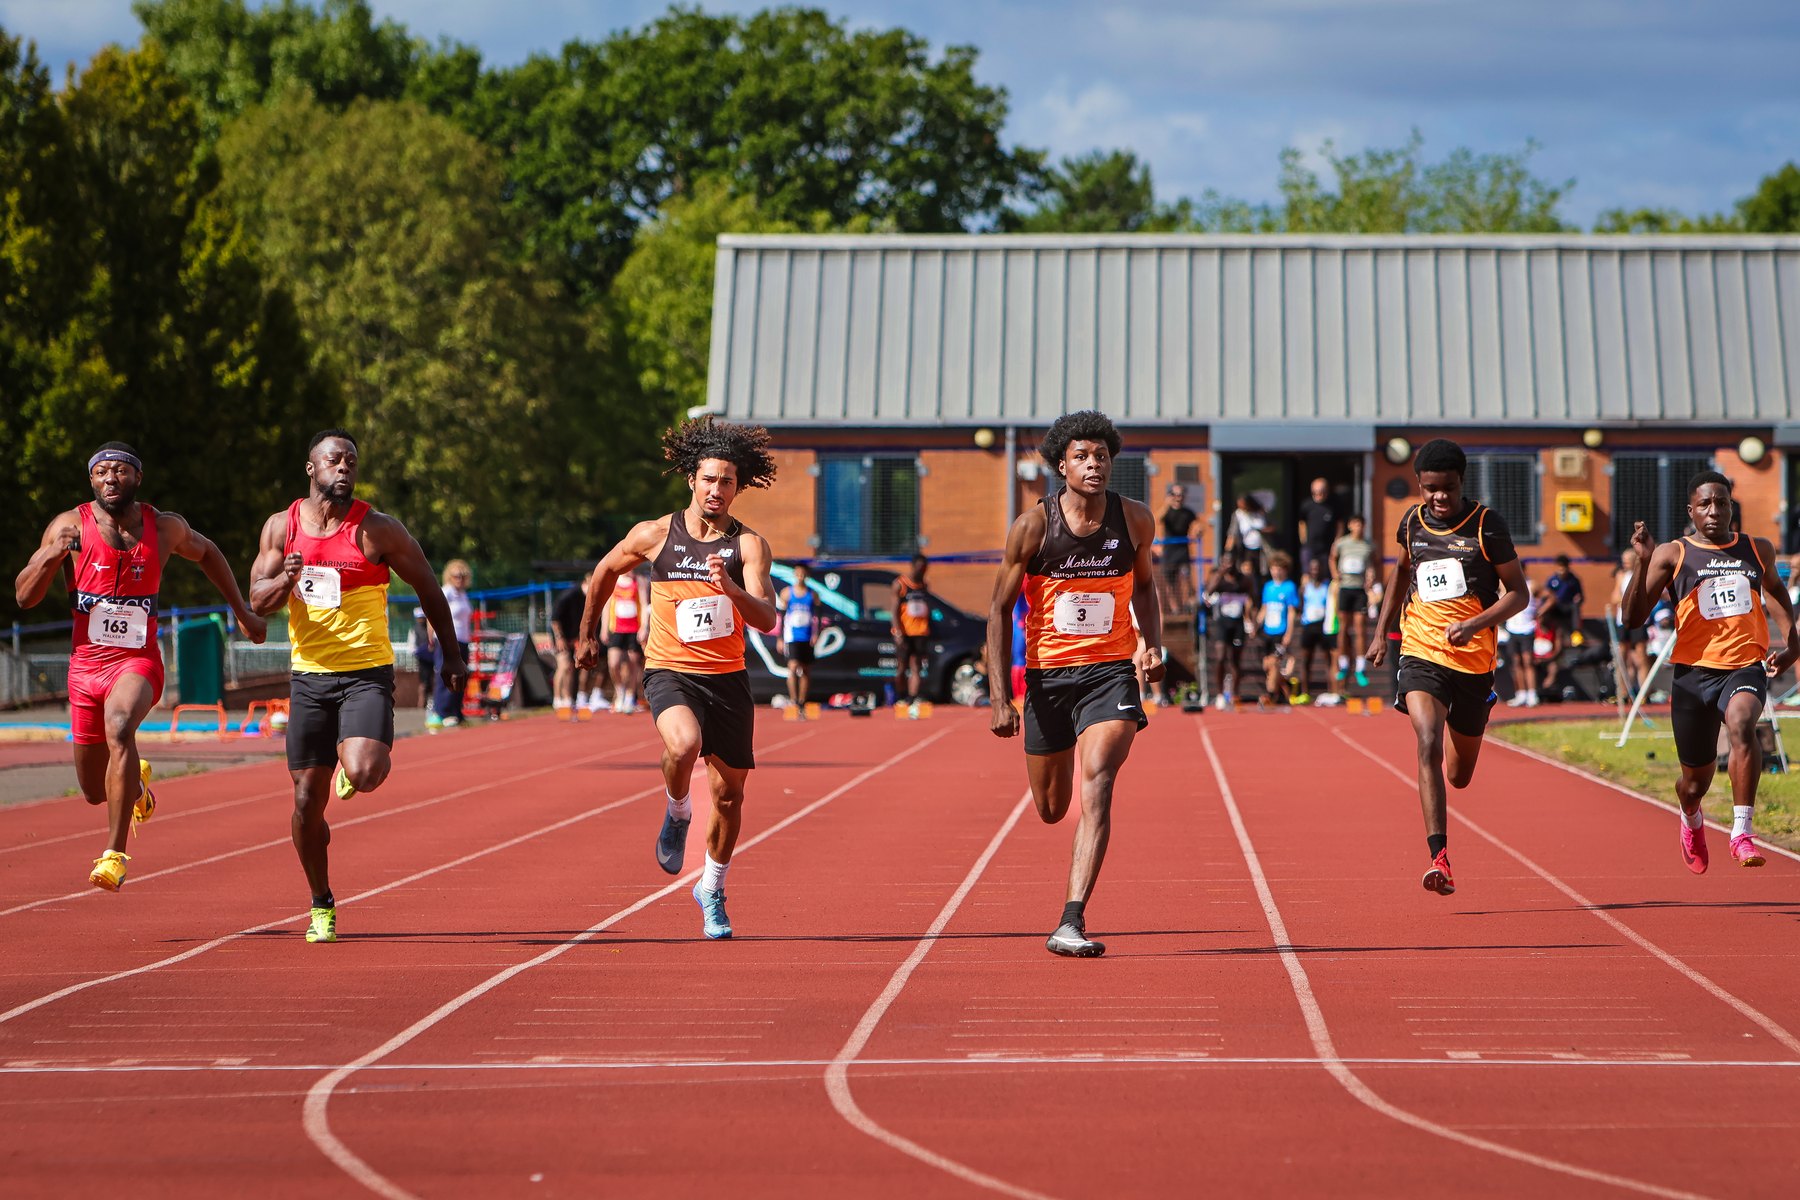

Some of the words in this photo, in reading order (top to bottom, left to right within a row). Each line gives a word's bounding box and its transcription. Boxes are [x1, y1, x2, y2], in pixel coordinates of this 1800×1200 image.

[674, 544, 686, 552] DPH
[315, 560, 360, 568] HARINGEY
[675, 555, 712, 571] Marsh
[1059, 554, 1113, 569] Marshall
[1706, 558, 1742, 568] Marshall
[667, 571, 692, 580] Milton
[693, 572, 712, 582] Keyn
[1050, 571, 1075, 579] Milton
[1077, 569, 1105, 577] Keynes
[1697, 569, 1719, 577] Milton
[1747, 570, 1757, 578] AC
[304, 579, 314, 592] 2
[1426, 574, 1447, 588] 134
[1710, 589, 1736, 605] 115
[693, 612, 713, 627] 74
[1076, 608, 1087, 622] 3
[102, 618, 128, 634] 163
